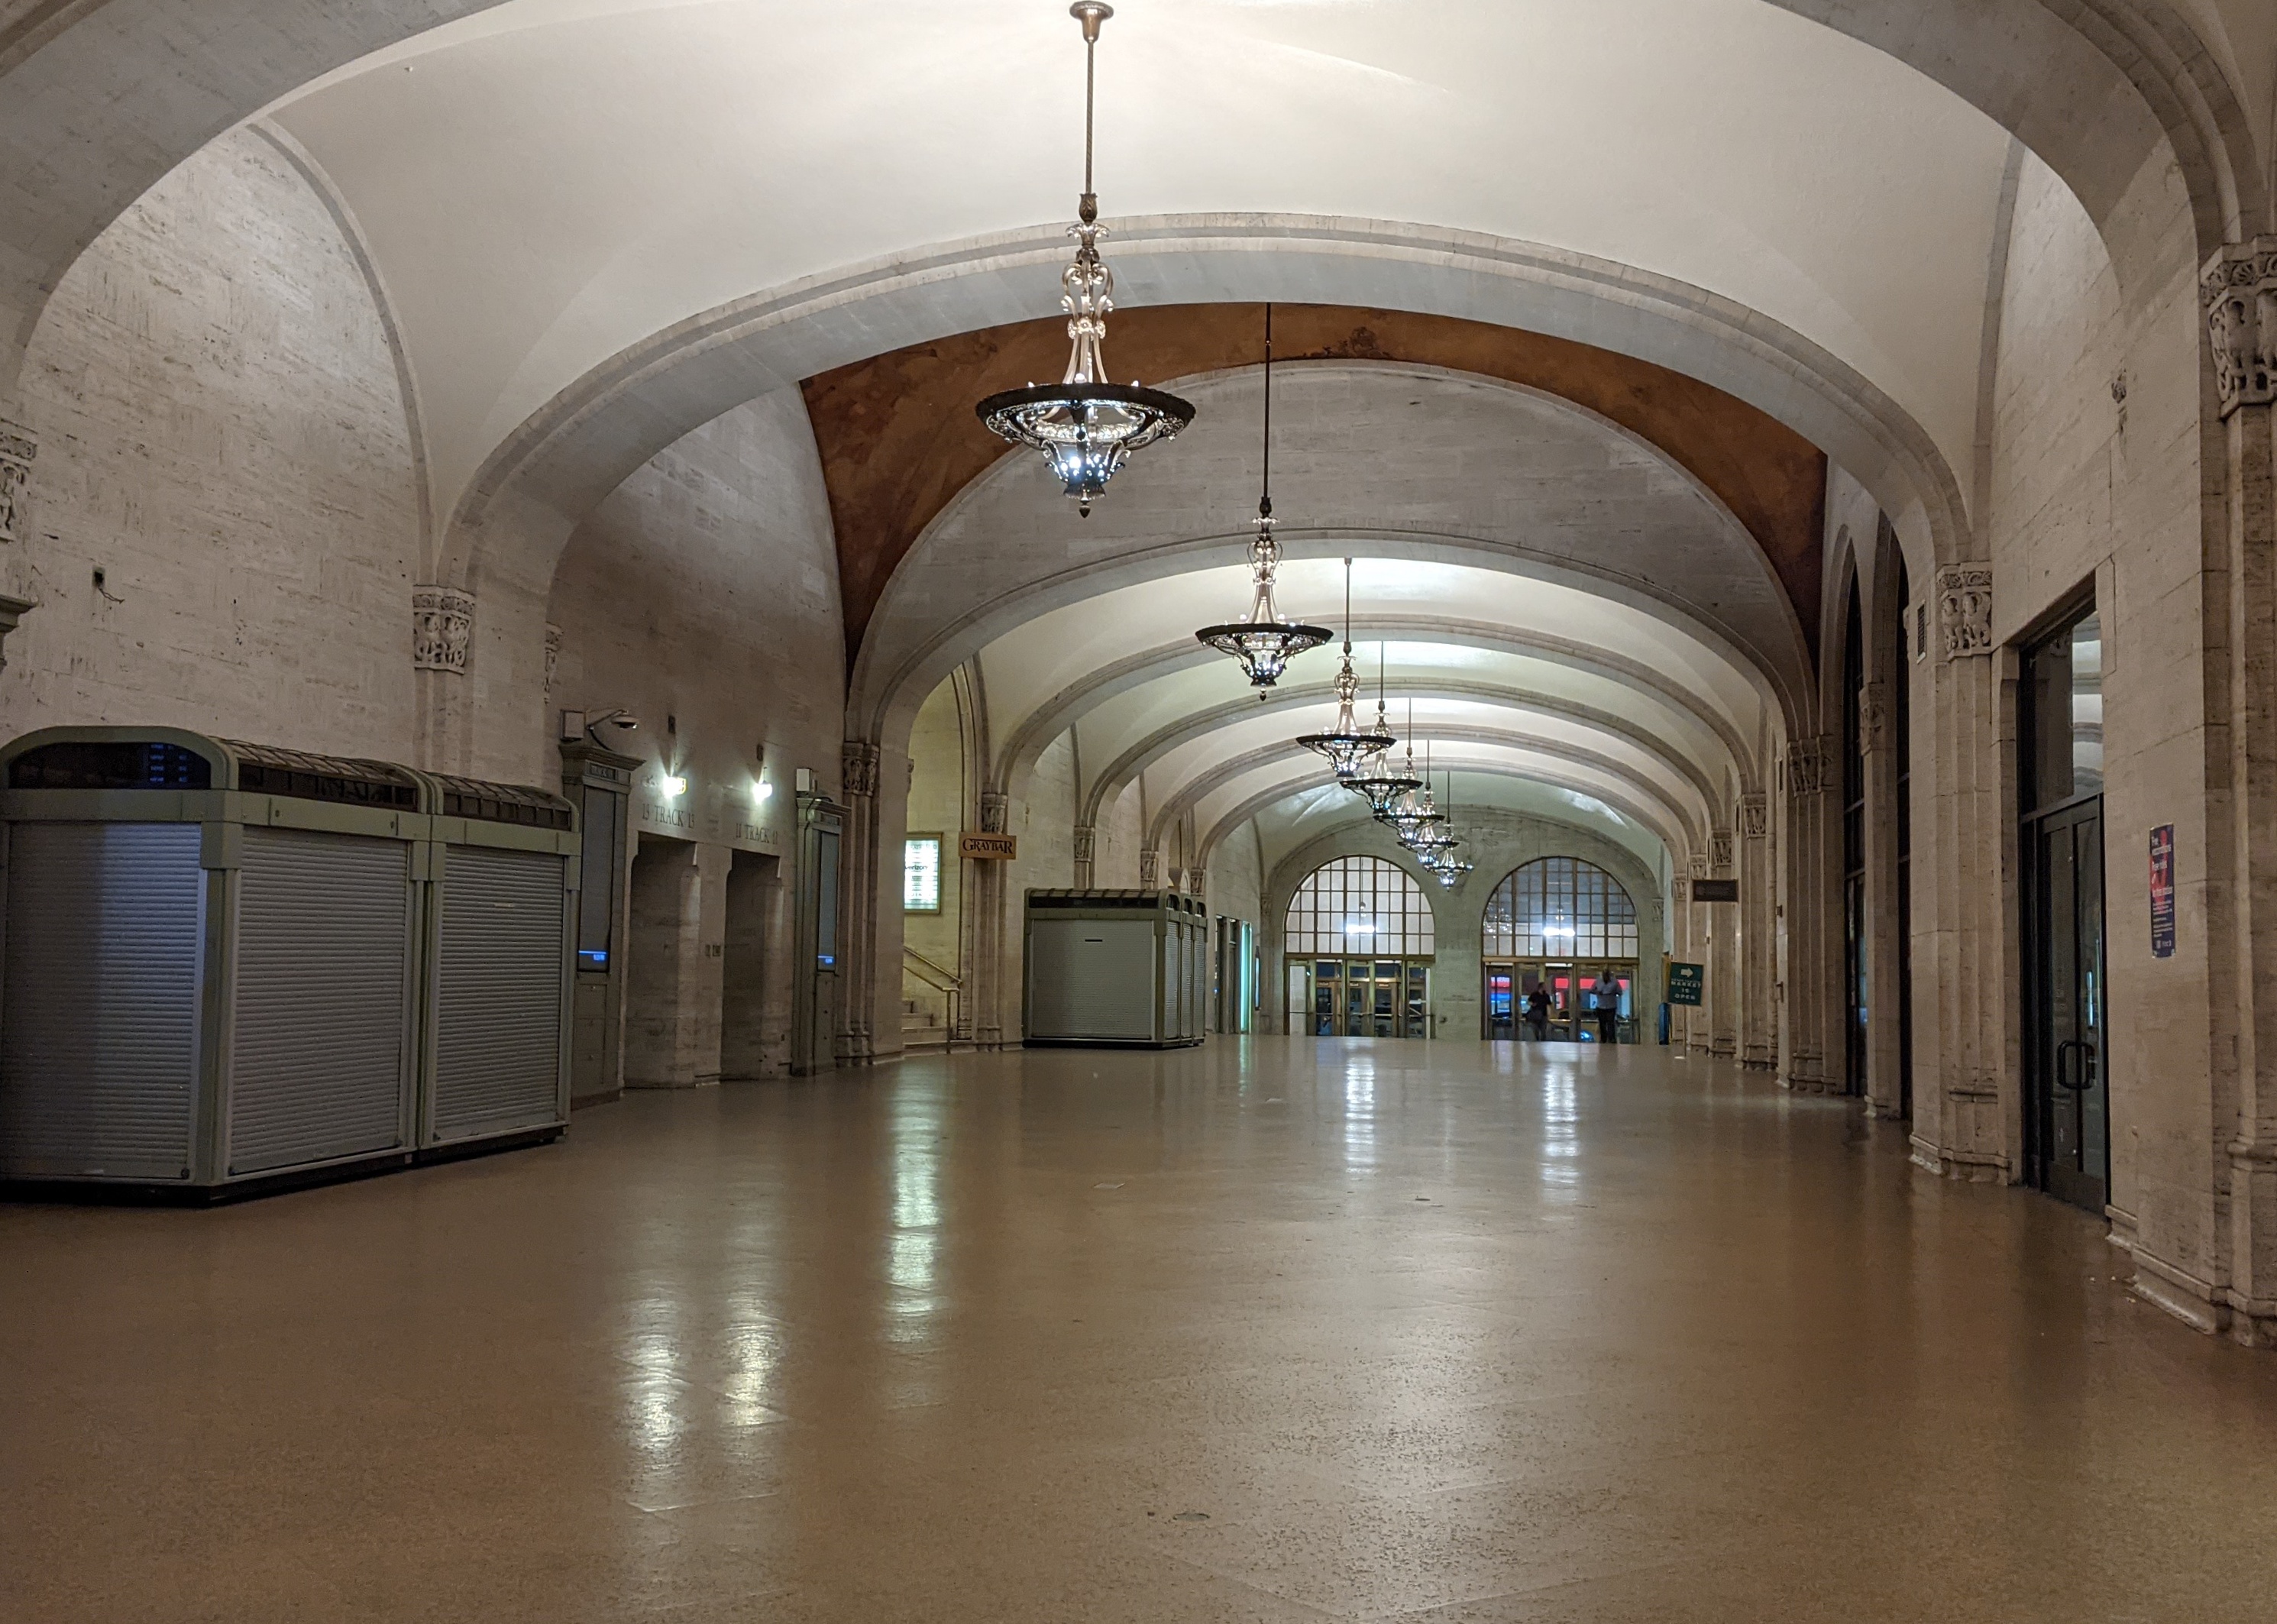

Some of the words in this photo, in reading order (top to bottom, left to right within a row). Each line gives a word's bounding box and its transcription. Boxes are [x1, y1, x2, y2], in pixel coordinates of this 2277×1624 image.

[654, 805, 684, 827] TRACK
[745, 824, 770, 844] TRACK
[962, 838, 1013, 854] GRAYBAR
